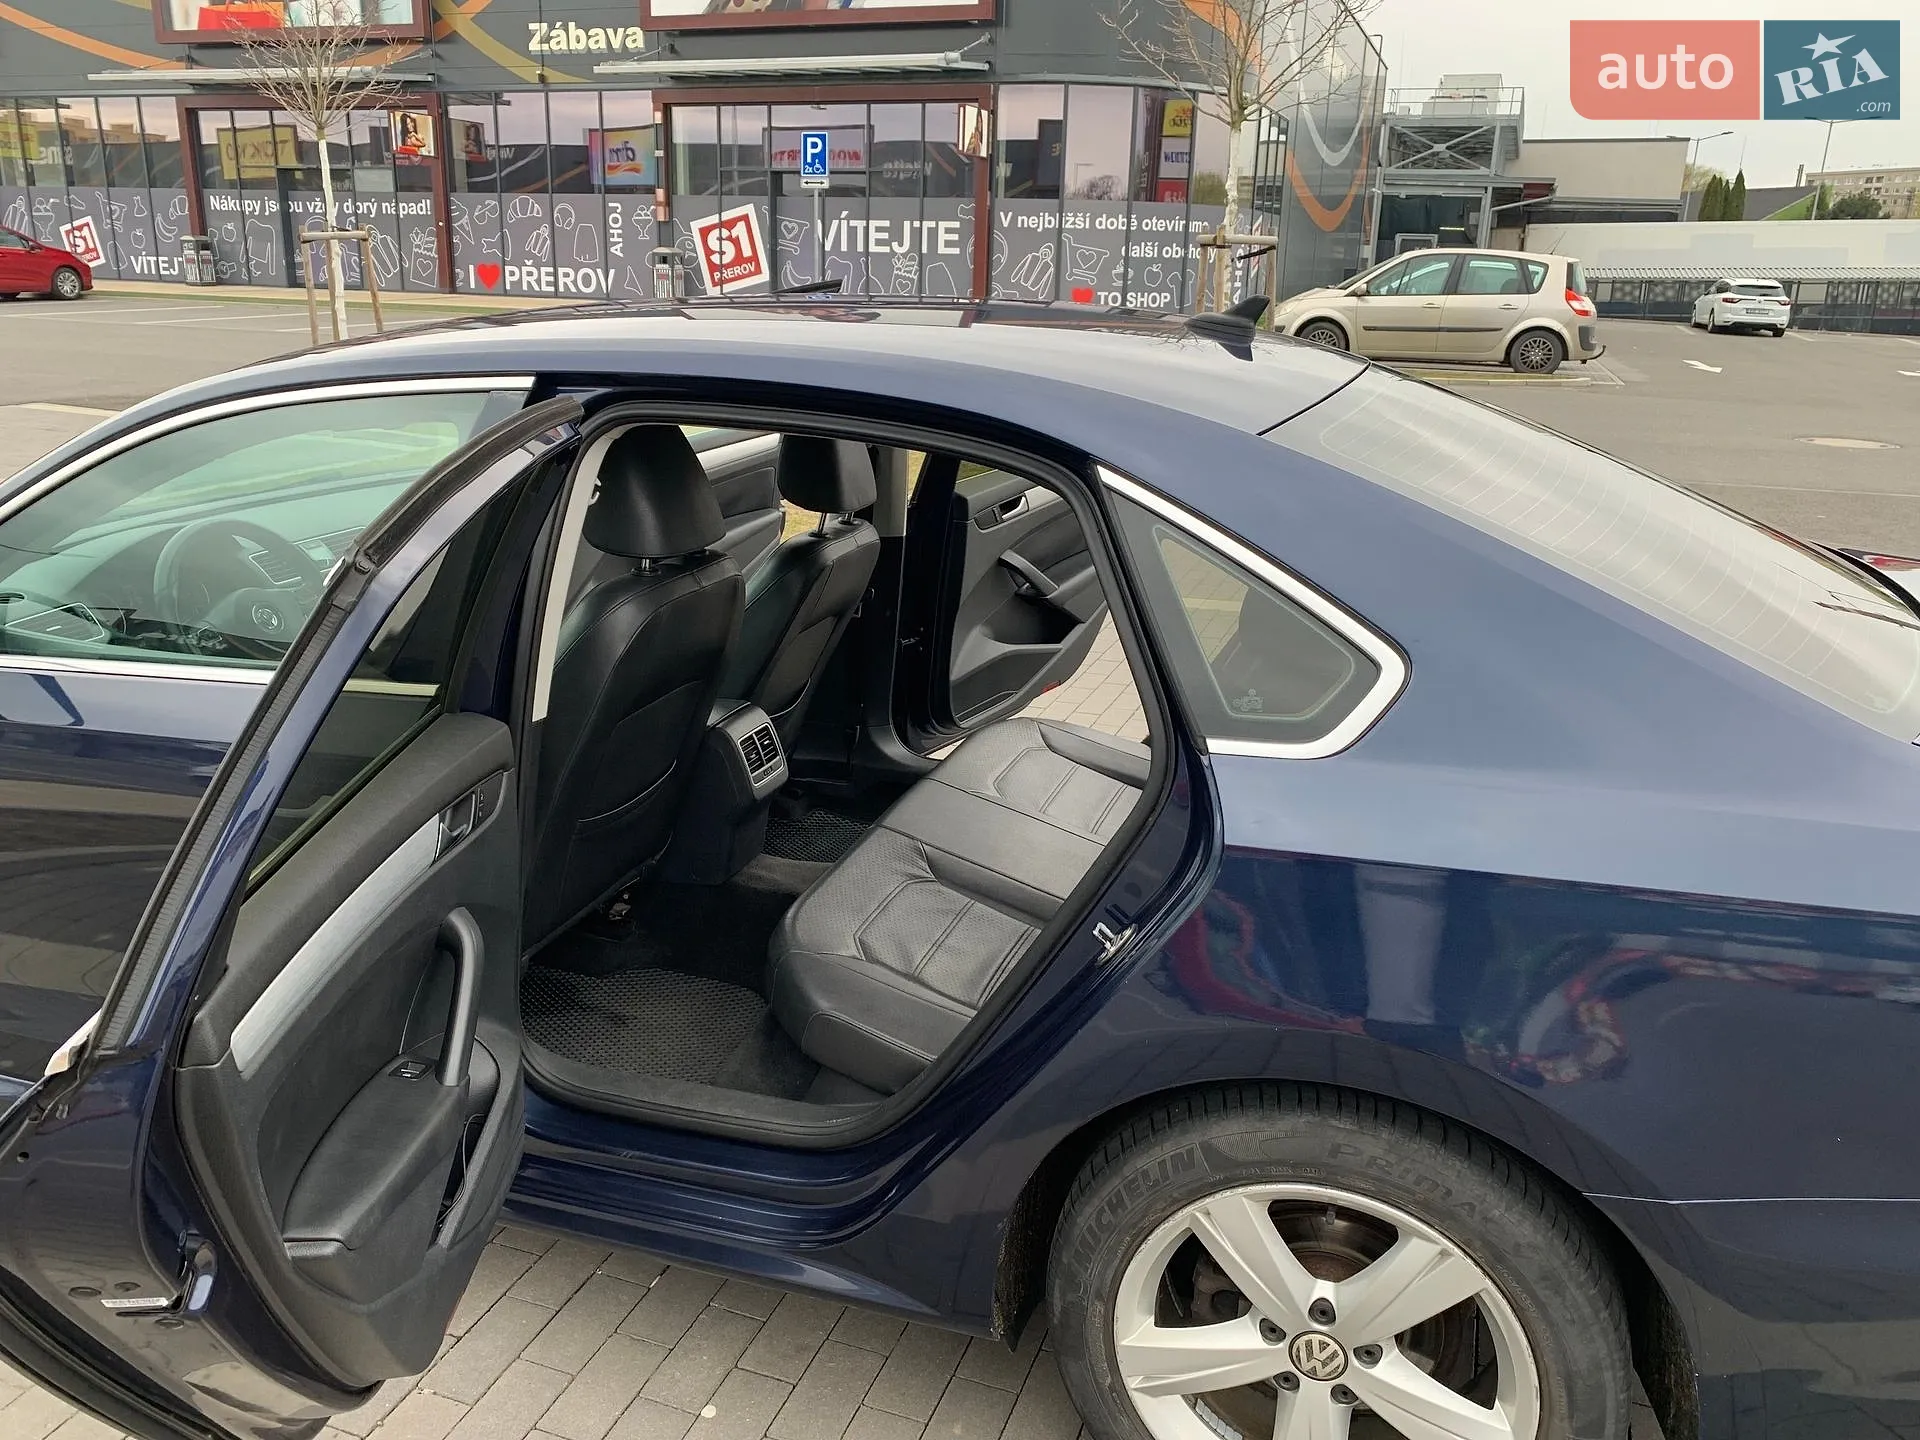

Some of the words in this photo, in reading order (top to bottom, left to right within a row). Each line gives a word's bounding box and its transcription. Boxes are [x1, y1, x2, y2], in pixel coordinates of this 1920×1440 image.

[528, 21, 645, 52] Zábava
[806, 137, 823, 164] P
[804, 165, 814, 173] 2x
[209, 195, 261, 215] Nákupy
[306, 198, 338, 216] vžy
[343, 198, 377, 218] dbrý
[382, 198, 431, 218] nápad!
[608, 202, 624, 258] AHOJ
[817, 210, 961, 255] VÍTEJTE
[999, 211, 1013, 228] V
[1017, 212, 1091, 232] nejbližší
[1095, 213, 1138, 230] době
[1142, 215, 1209, 233] otevírm
[69, 225, 95, 254] S1
[706, 219, 754, 266] S1
[1162, 243, 1216, 264] obhoy
[468, 264, 476, 289] I
[504, 259, 616, 294] PŘEROV
[712, 260, 757, 283] PŘEROV
[1232, 244, 1245, 304] AHO
[1096, 291, 1122, 306] TO
[1126, 291, 1171, 308] SHOP
